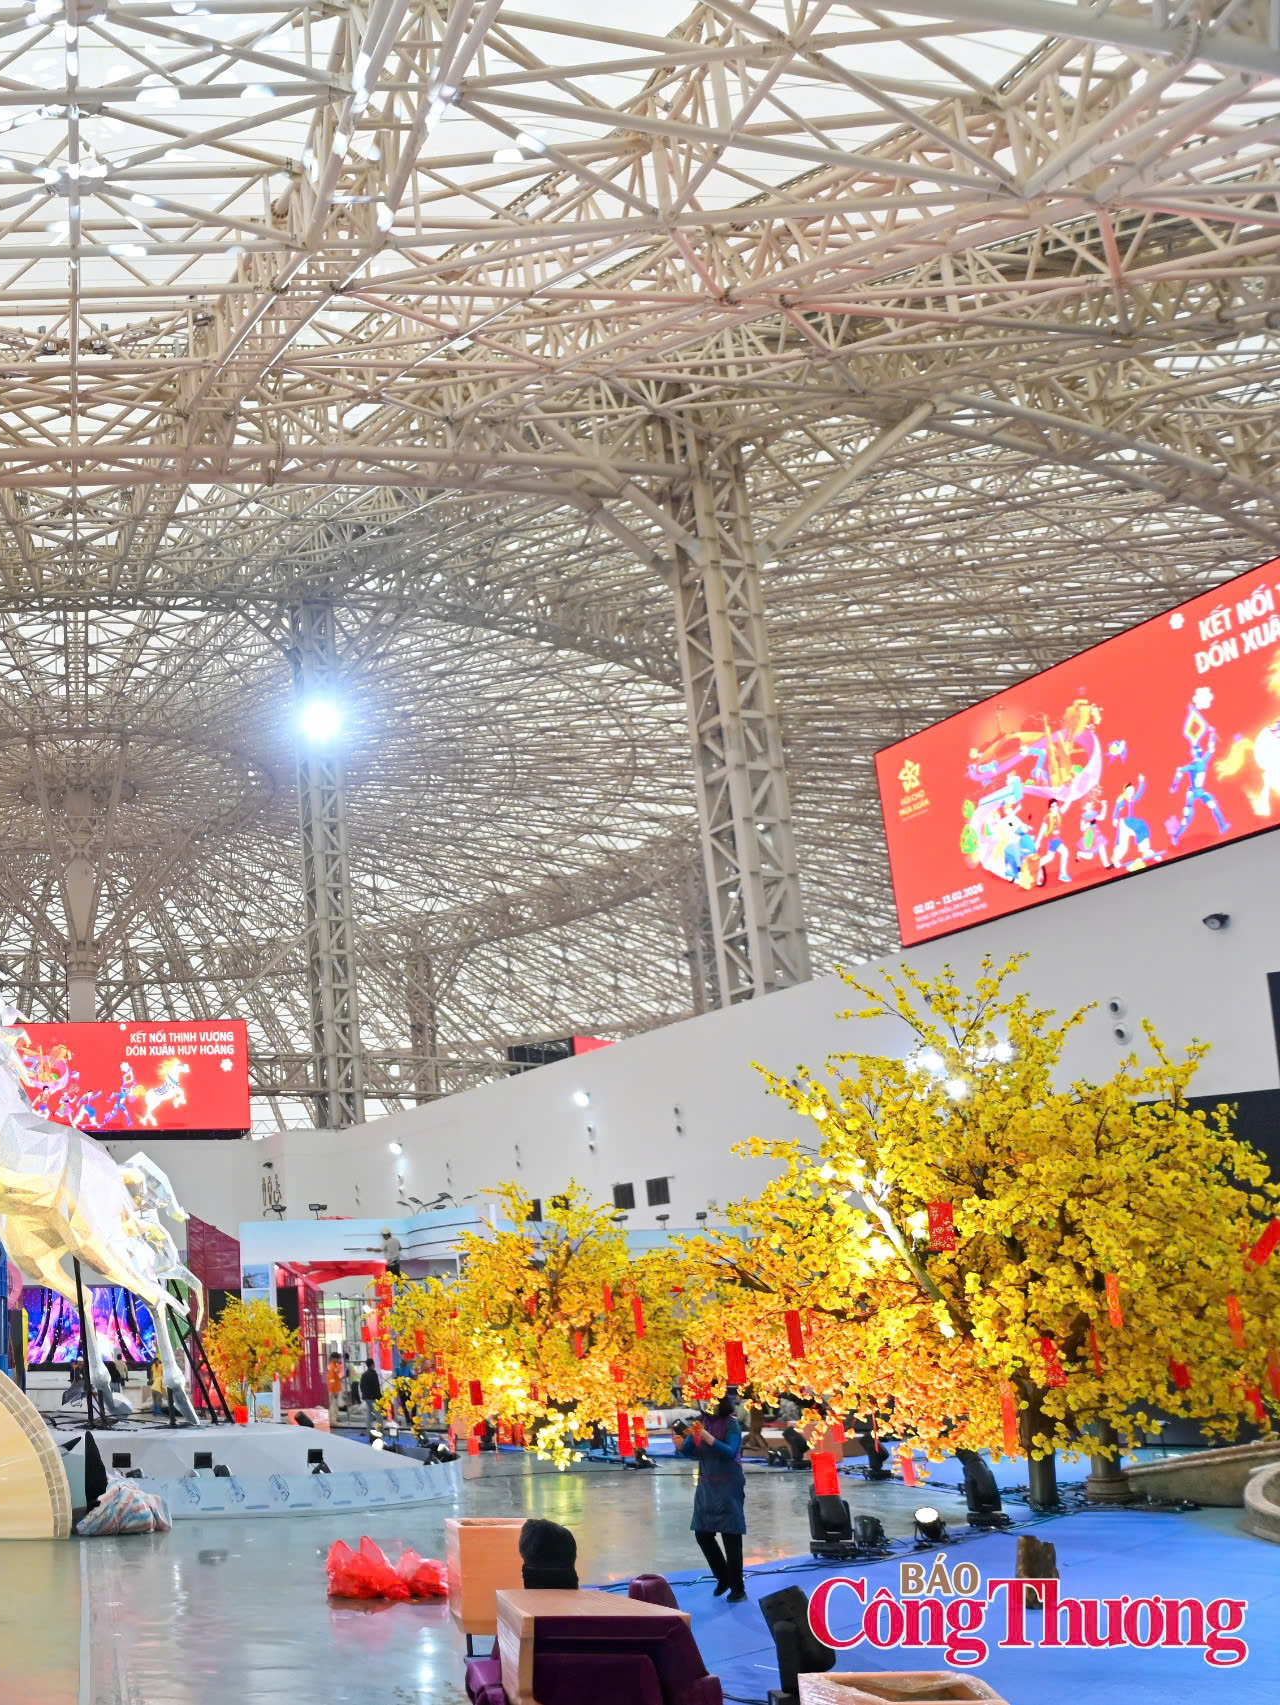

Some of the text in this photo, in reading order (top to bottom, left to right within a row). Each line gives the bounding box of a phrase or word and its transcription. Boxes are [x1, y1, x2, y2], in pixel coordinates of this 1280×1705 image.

[1198, 584, 1275, 642] KẾT NỐI
[1240, 614, 1280, 654] XUÂ
[130, 1029, 147, 1043] KẾT
[149, 1029, 167, 1043] NỐI
[168, 1032, 197, 1043] THỊNH
[149, 1044, 175, 1056] XUÂN
[177, 1045, 198, 1055] HUY
[199, 1042, 235, 1055] HOÀNG
